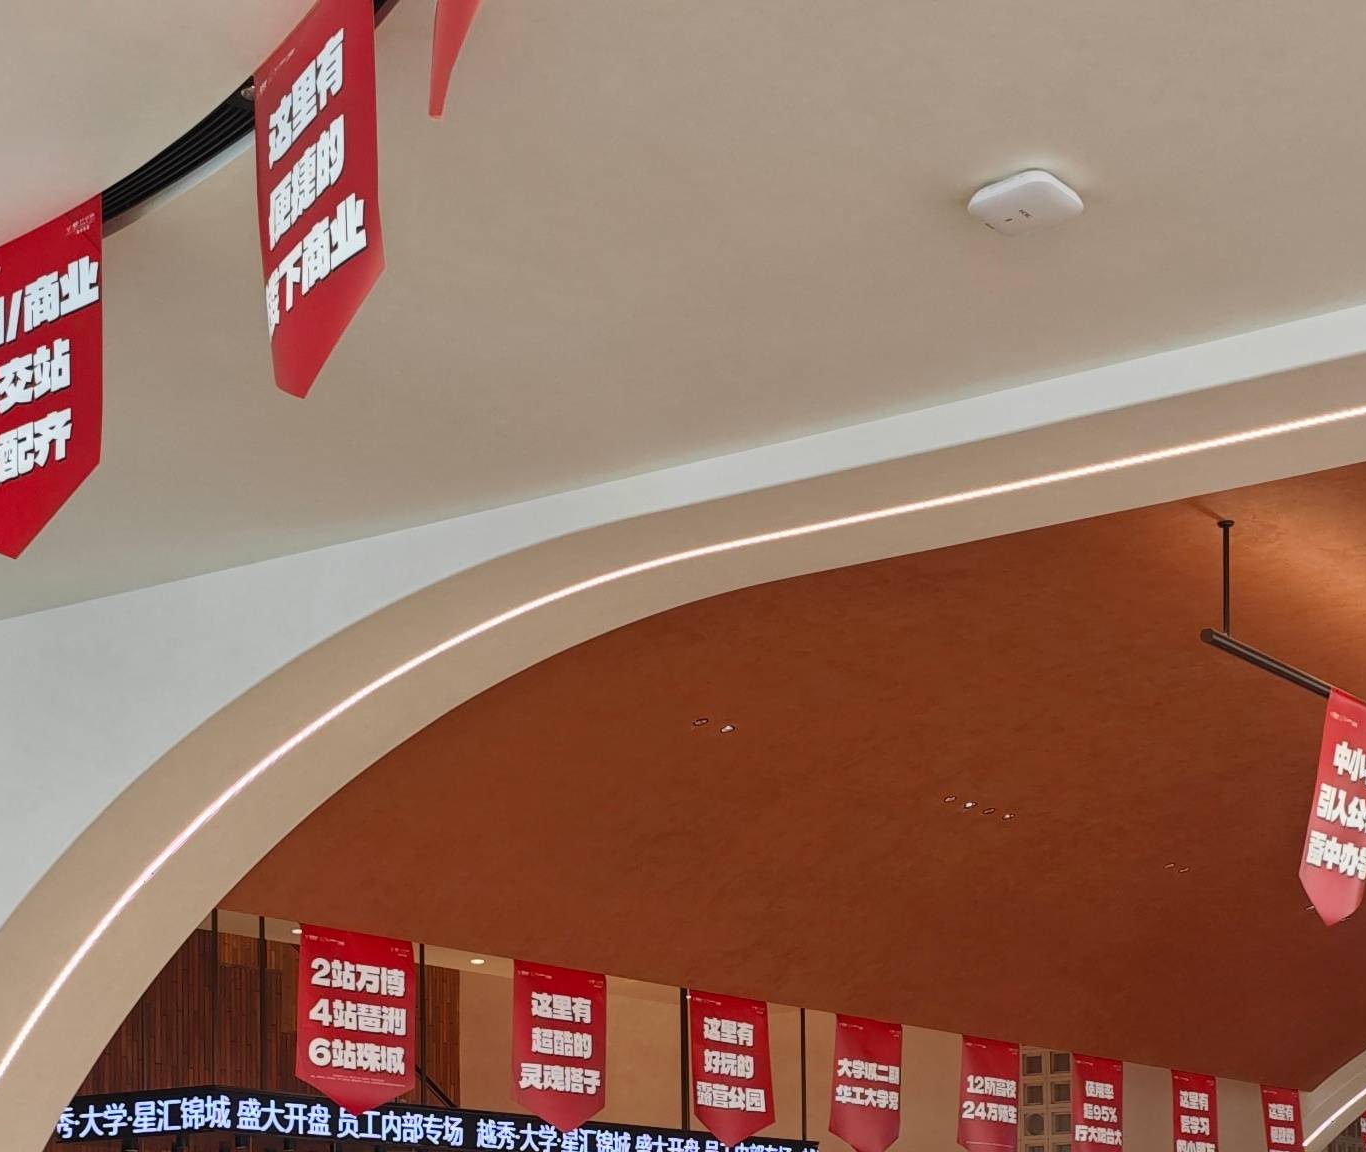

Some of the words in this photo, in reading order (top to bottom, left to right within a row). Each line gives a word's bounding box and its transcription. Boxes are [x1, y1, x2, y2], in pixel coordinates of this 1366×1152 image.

[269, 28, 344, 170] 这里有
[311, 957, 405, 997] 2站万博
[309, 998, 407, 1036] 4站琶洲
[531, 991, 592, 1024] 这里有
[531, 1027, 593, 1060] 超酷的
[703, 1016, 755, 1047] 这里有
[519, 1063, 601, 1095] 灵魂搭子
[703, 1048, 755, 1080] 好玩的
[696, 1080, 767, 1113] 露营公园
[237, 1098, 332, 1136] 盛大开盘
[337, 1107, 464, 1147] 员工内部专场
